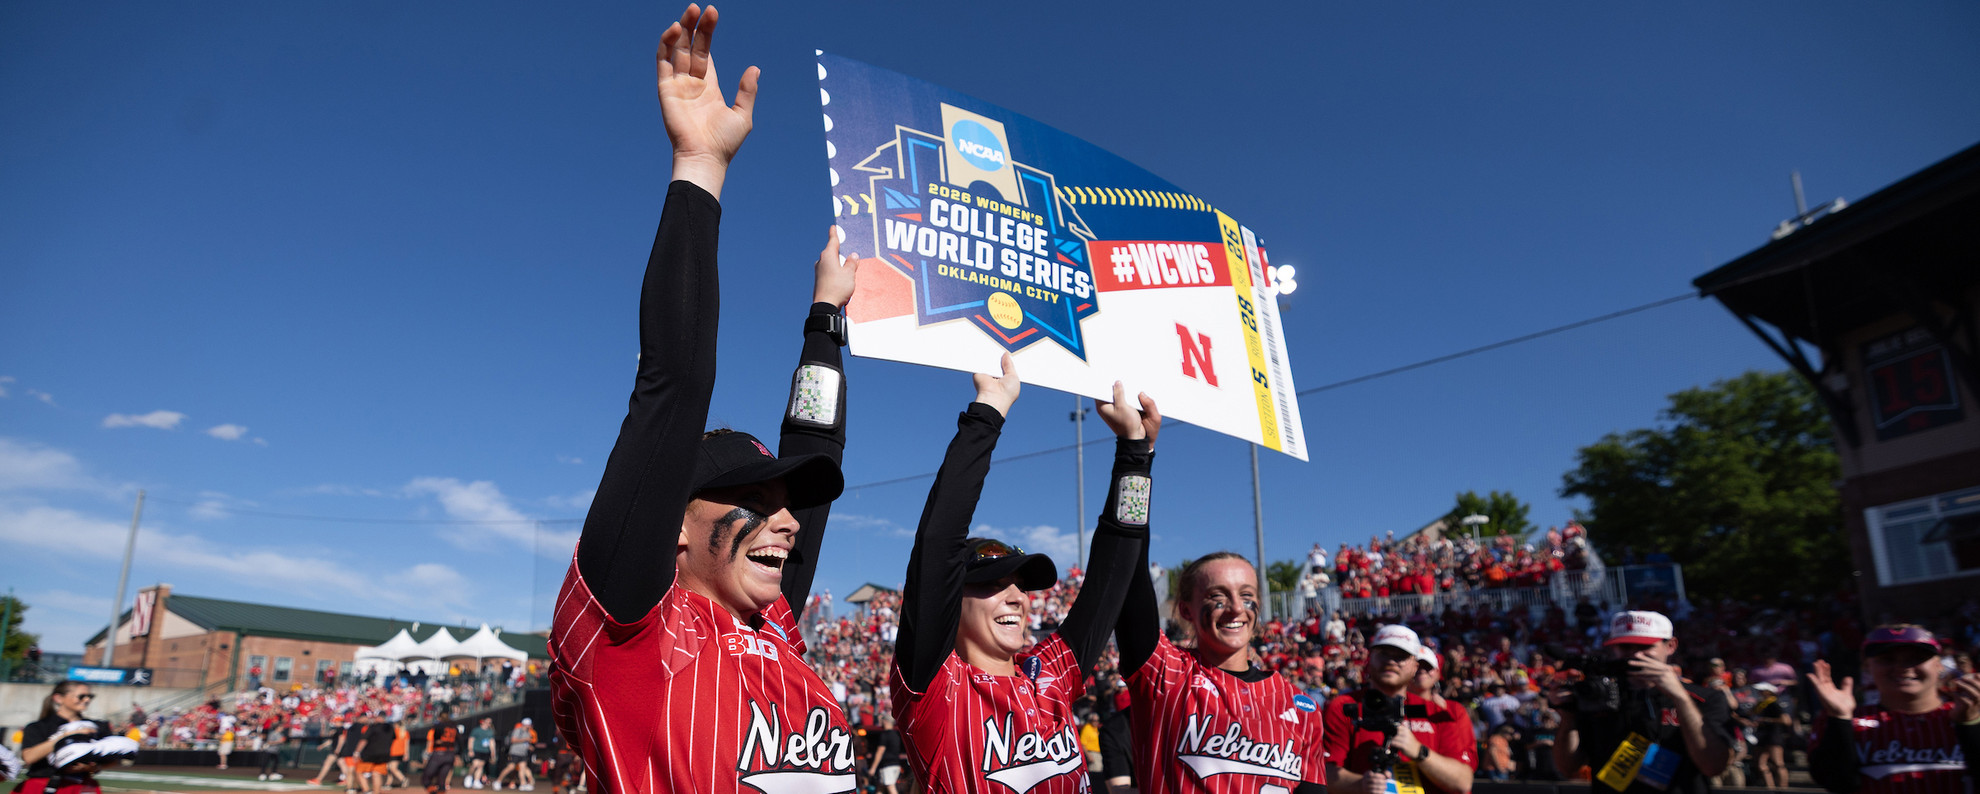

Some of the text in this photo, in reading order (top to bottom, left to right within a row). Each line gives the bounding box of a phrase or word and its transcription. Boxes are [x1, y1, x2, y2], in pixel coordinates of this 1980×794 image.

[959, 138, 1004, 164] NCAA
[928, 183, 1044, 226] 2026 WOMEN'S
[930, 198, 1048, 256] COLLEGE
[1223, 224, 1243, 262] 26
[885, 219, 1091, 299] WORLD SERIES
[1110, 243, 1215, 286] #WCWS
[938, 264, 1059, 304] OKLAHOMA CITY
[1238, 294, 1258, 333] 28
[1175, 322, 1220, 388] N
[1252, 366, 1269, 389] 5
[1875, 352, 1944, 413] 15
[1260, 391, 1276, 439] SECTION
[1296, 700, 1316, 711] NCAA
[1177, 713, 1302, 777] Nebraska
